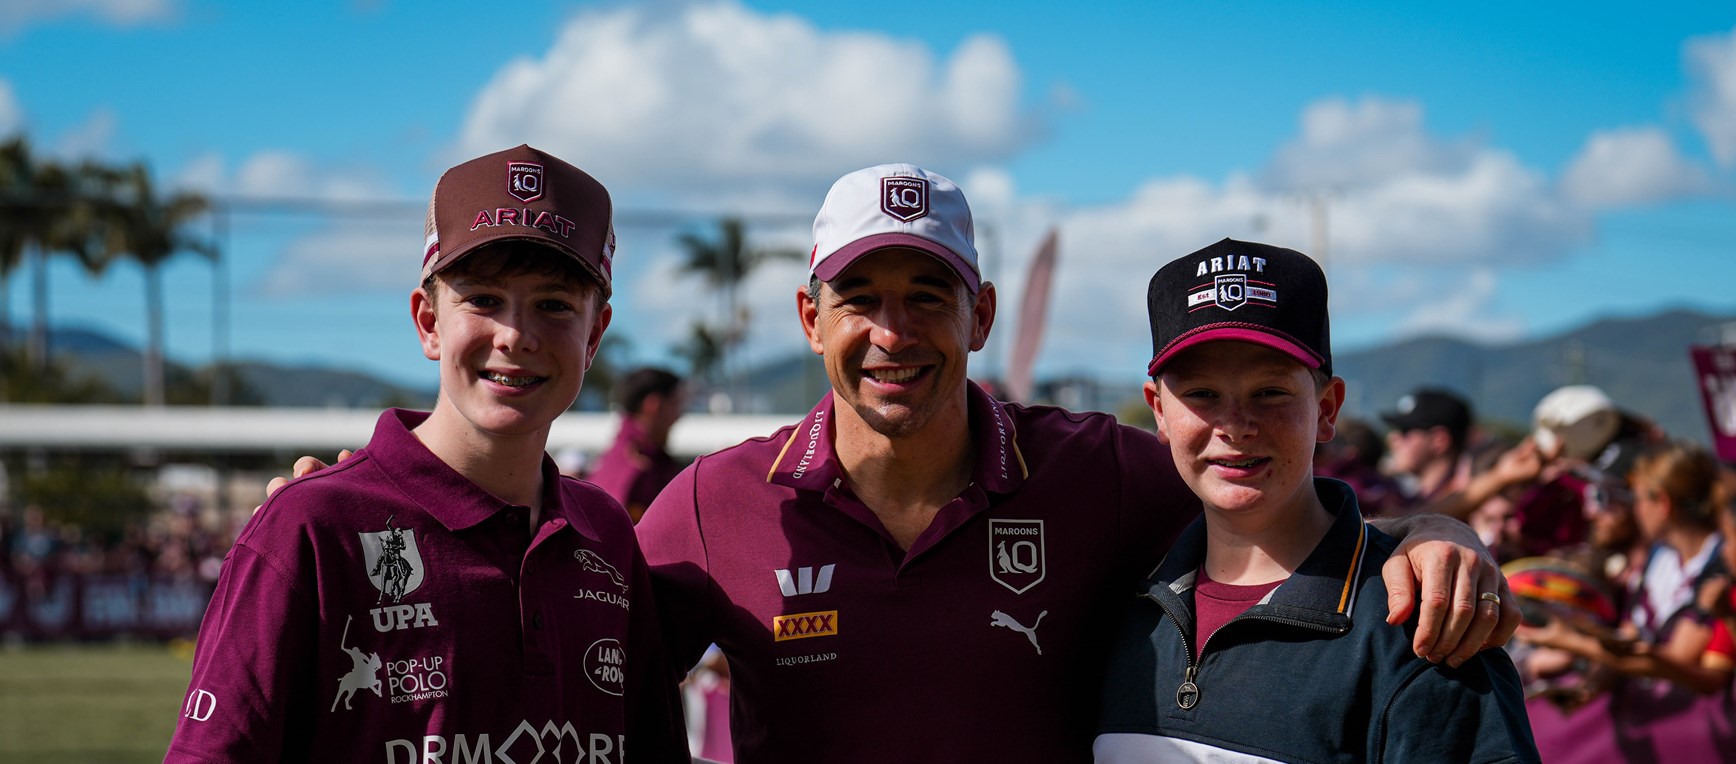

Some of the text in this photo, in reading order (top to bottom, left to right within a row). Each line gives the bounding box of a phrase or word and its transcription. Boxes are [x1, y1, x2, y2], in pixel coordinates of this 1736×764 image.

[511, 166, 541, 174] MAROONS
[470, 207, 575, 238] ARIAT
[1196, 254, 1267, 277] ARIAT
[792, 410, 824, 479] LIQUORLAND
[994, 527, 1038, 535] MAROONS
[573, 588, 630, 611] JAGUAR
[369, 602, 439, 632] UPA
[778, 614, 834, 637] XXXX
[386, 656, 443, 676] POP-UP
[776, 652, 837, 666] LIQUORLAND
[388, 671, 447, 695] POLO
[391, 690, 449, 704] ROCKHAMPTON
